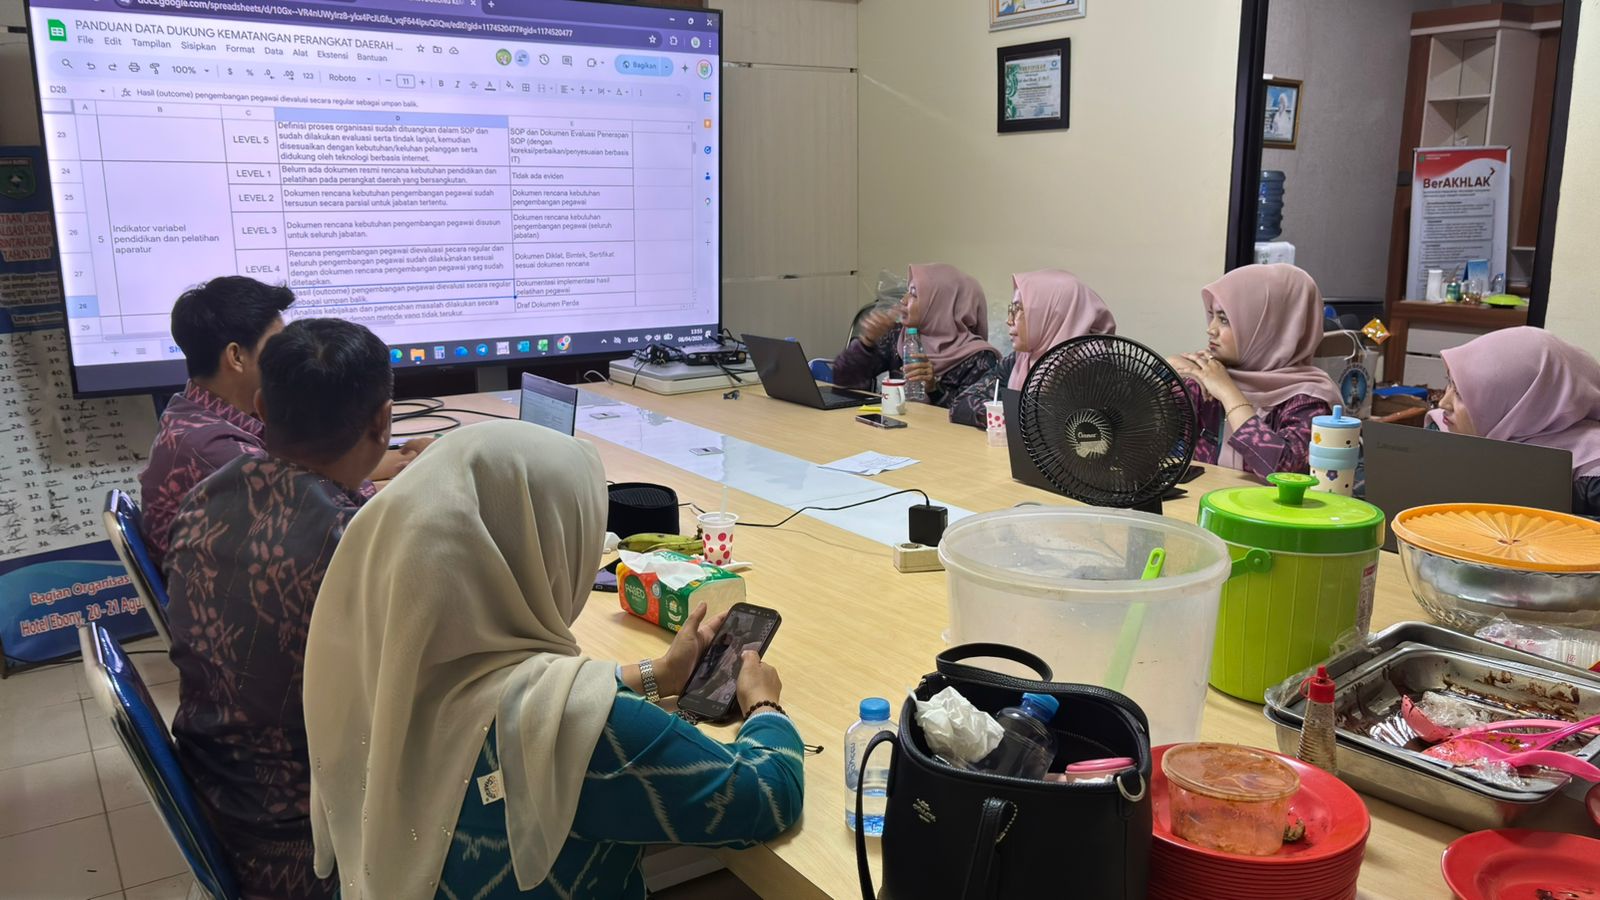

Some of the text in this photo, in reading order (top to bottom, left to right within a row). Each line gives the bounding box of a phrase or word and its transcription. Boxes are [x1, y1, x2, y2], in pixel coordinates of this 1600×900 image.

[75, 20, 393, 49] PANDUAN DATA DUKUNG KEMATANGAN PERANGKAT DAERAH
[76, 35, 387, 61] File Edit Tampilan Sisipkan Format Data Alat Ekstensi Bantuan
[172, 66, 196, 74] 100%
[329, 73, 356, 82] Roboto
[136, 88, 154, 96] Hasil
[155, 89, 193, 100] (outcome)
[194, 90, 249, 102] pengembangan
[250, 93, 278, 103] pegawai
[332, 96, 354, 107] regular
[355, 97, 380, 108] sebagai
[277, 121, 488, 135] Definisi proses organisasi sudah dituangkan dalam SOP dan
[232, 135, 261, 143] LEVEL
[278, 131, 302, 139] sudah
[303, 132, 340, 140] dilakukan
[341, 132, 371, 141] evaluasi
[392, 134, 414, 142] tindak
[437, 135, 470, 143] kemudian
[539, 128, 569, 136] Dokumen
[570, 129, 595, 137] Evaluasi
[596, 130, 629, 140] Penerapan
[510, 136, 552, 147] SOP (dengan
[279, 141, 325, 150] disesuaikan
[326, 142, 354, 153] dengan
[423, 144, 459, 154] pelanggan
[280, 151, 315, 162] didukung
[317, 152, 333, 160] oleh
[334, 152, 368, 162] teknologi
[370, 152, 400, 161] berbasis
[235, 169, 264, 178] LEVEL
[446, 166, 483, 176] pendidikan
[282, 175, 317, 185] pelatihan
[318, 175, 338, 185] pada
[338, 175, 375, 185] perangkat
[1424, 176, 1490, 188] BerAKHLAK
[238, 194, 266, 202] LEVEL
[390, 188, 444, 198] pengembangan
[444, 188, 472, 198] pegawai
[345, 198, 369, 208] parsial
[392, 198, 418, 208] jabatan
[512, 197, 586, 207] pengembangan pegawai
[112, 223, 186, 232] Indikator variabel
[286, 220, 322, 228] Dokumen
[354, 219, 392, 227] kebutuhan
[392, 218, 445, 229] pengembangan
[446, 218, 474, 228] pegawai
[475, 218, 500, 226] disusun
[513, 221, 612, 231] pengembangan pegawai (seluruh
[241, 226, 269, 234] LEVEL
[310, 230, 337, 238] seluruh
[513, 230, 540, 241] jabatan)
[113, 233, 219, 245] pendidikan dan pelatihan
[114, 245, 153, 256] aparatur
[245, 265, 273, 273] LEVEL
[31, 577, 130, 605] Bagian Organisas
[21, 618, 48, 636] Hotel
[50, 611, 85, 630] Ebony,
[121, 598, 144, 615] Agu
